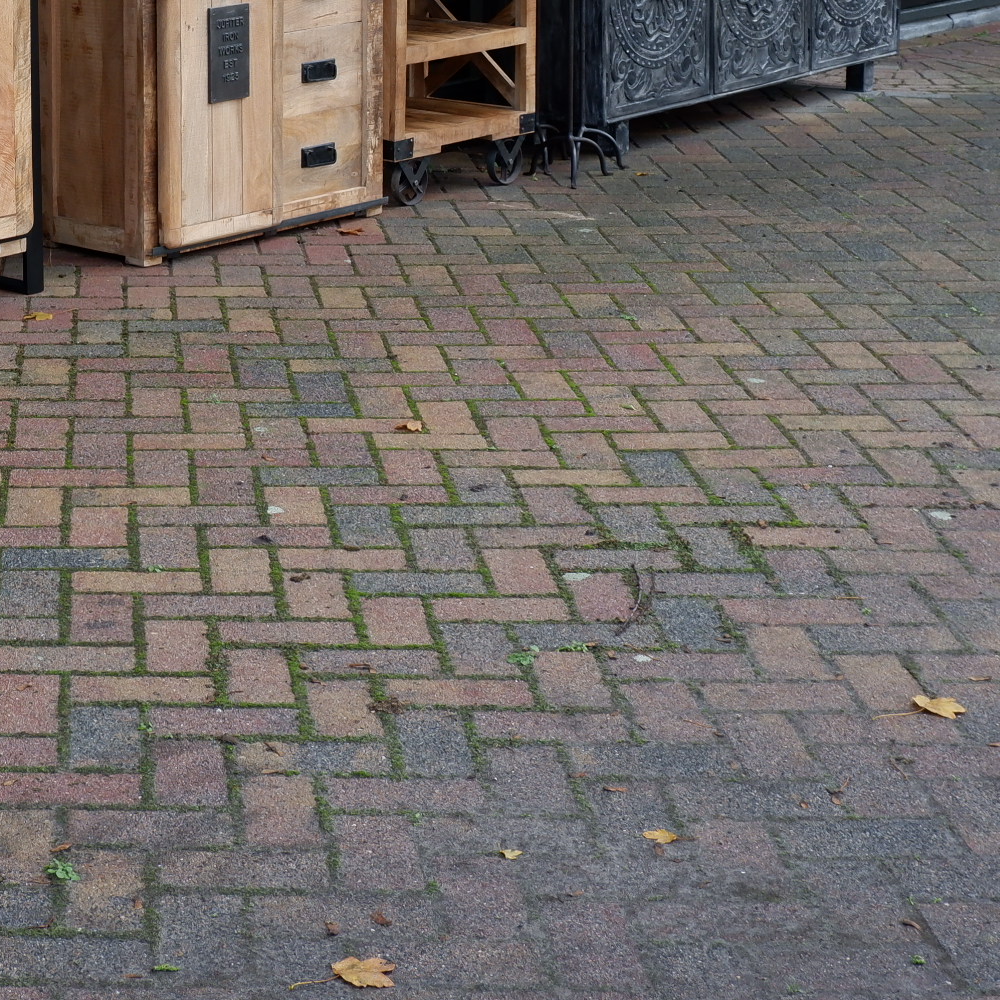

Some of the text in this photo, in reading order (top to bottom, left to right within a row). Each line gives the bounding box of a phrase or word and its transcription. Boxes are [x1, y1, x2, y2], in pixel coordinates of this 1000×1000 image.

[216, 16, 244, 29] JUPITER
[222, 31, 239, 42] IRON
[218, 44, 244, 56] WORKS
[223, 58, 238, 69] EST
